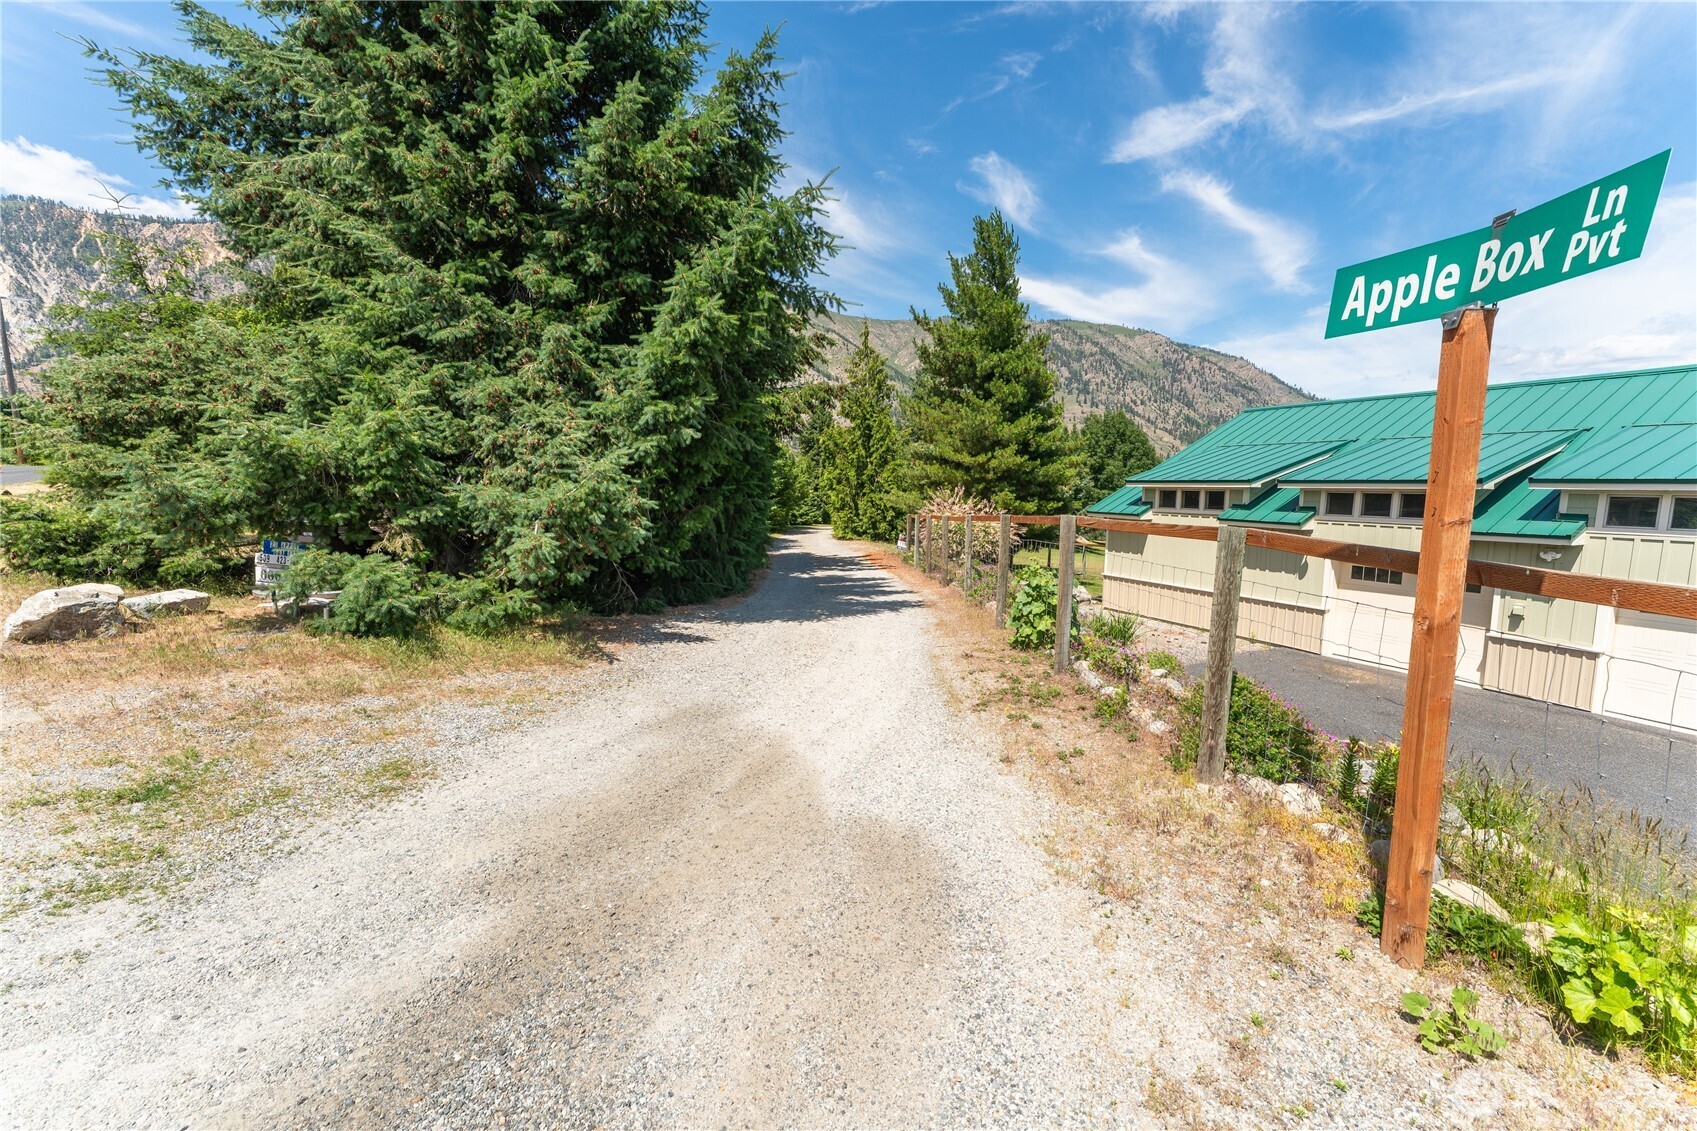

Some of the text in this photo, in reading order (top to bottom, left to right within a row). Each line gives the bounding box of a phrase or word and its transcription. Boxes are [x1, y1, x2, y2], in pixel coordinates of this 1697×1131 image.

[1582, 184, 1629, 229] Ln
[1341, 218, 1628, 328] Apple Box Pvt
